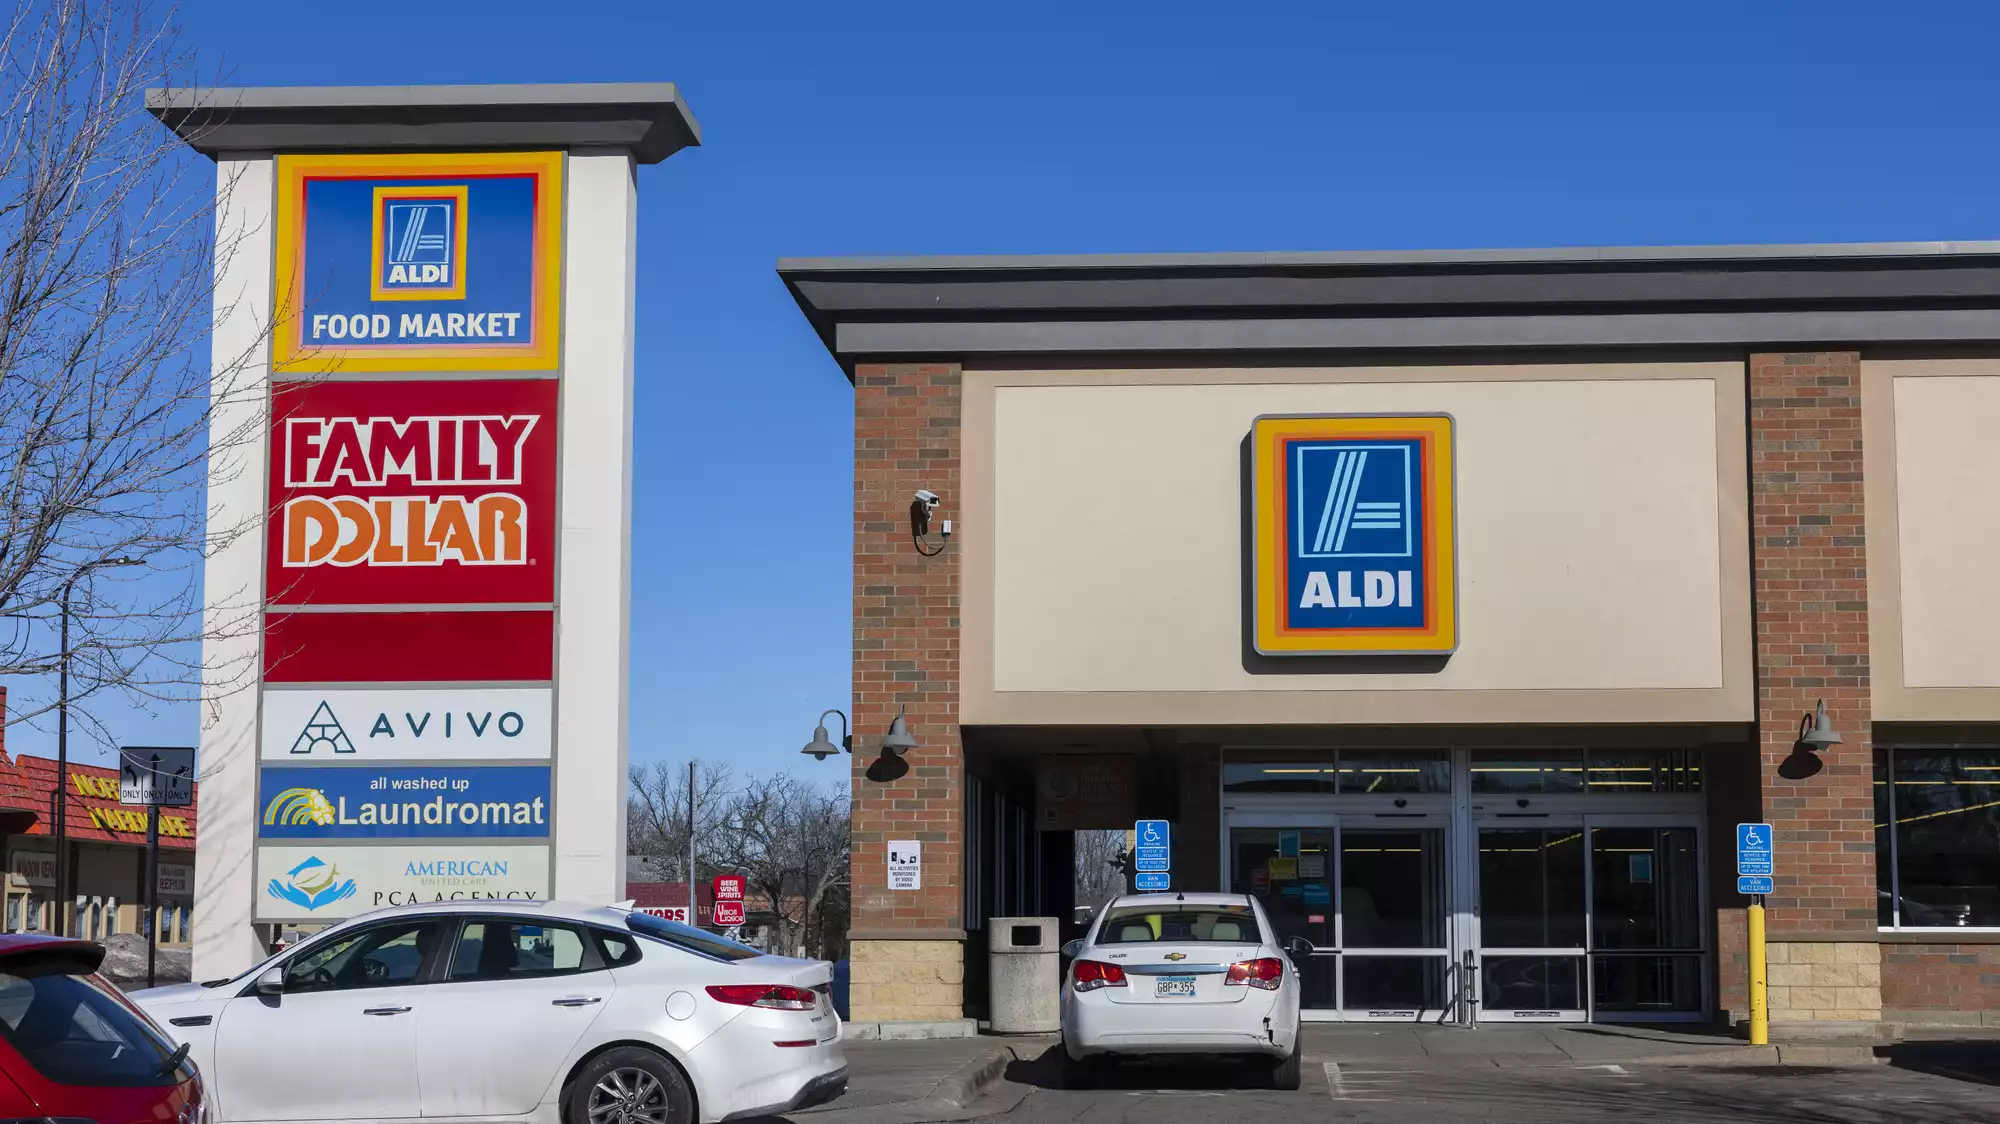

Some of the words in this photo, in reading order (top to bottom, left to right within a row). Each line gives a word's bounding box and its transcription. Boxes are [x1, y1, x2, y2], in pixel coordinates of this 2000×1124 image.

[388, 264, 448, 283] ALDI
[313, 314, 390, 339] FOOD
[399, 312, 521, 338] MARKET
[284, 415, 541, 487] FAMILY
[283, 492, 528, 568] DOLLAR
[1300, 570, 1412, 608] ALDI
[369, 712, 524, 738] AVIVO
[370, 777, 387, 790] all
[391, 777, 447, 790] washed
[452, 779, 469, 792] up
[122, 790, 140, 799] ONLY
[143, 790, 163, 799] ONLY
[168, 791, 189, 799] ONLY
[339, 796, 544, 825] Laundromat
[404, 861, 509, 876] AMERICAN
[159, 878, 186, 892] REPAIR
[421, 878, 462, 886] UNITED
[463, 878, 489, 886] CARE
[373, 891, 418, 906] PCA
[1157, 981, 1173, 993] GBP
[1179, 981, 1195, 993] 355
